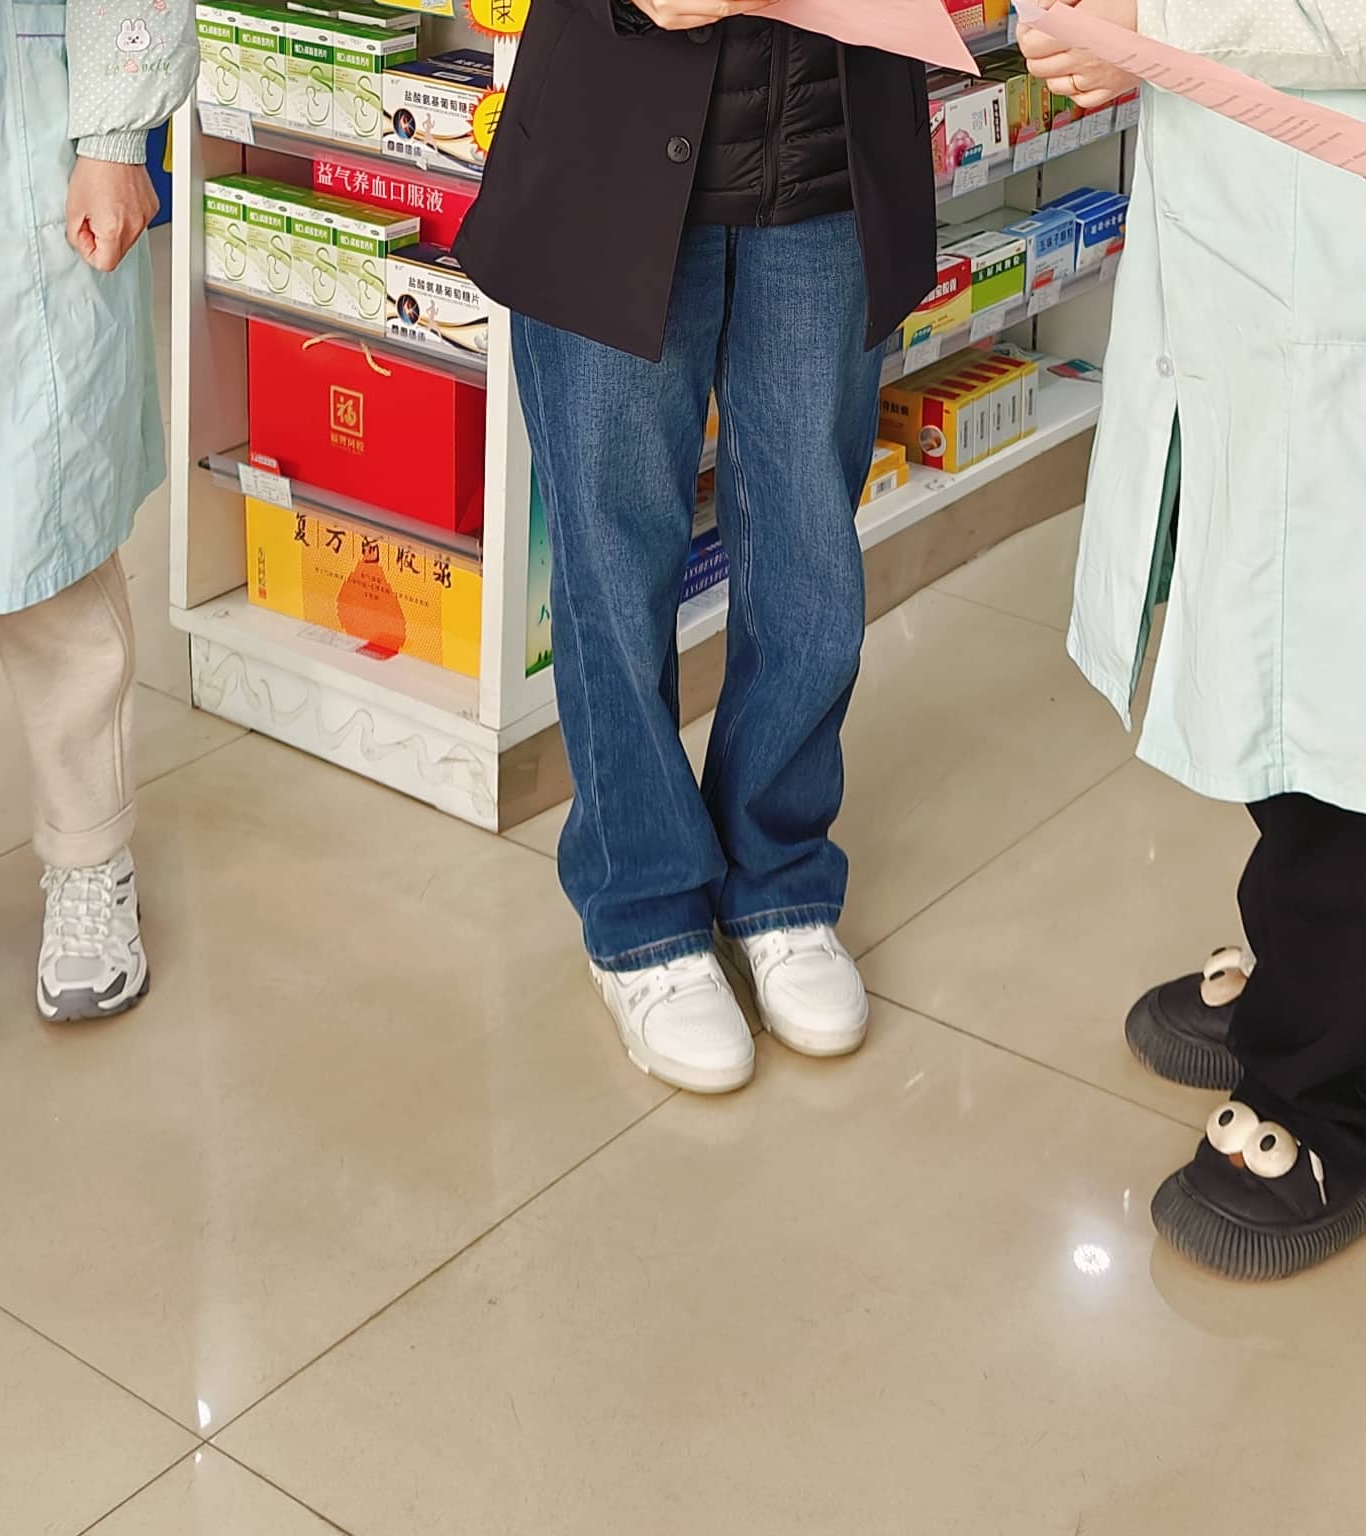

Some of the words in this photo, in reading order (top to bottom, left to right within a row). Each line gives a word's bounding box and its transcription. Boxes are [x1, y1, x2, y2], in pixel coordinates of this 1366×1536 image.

[316, 160, 444, 214] 益气养血口服液
[407, 275, 481, 306] 盐酸氨基葡萄糖片
[336, 395, 358, 427] 福
[293, 512, 453, 589] 复方阿胶浆
